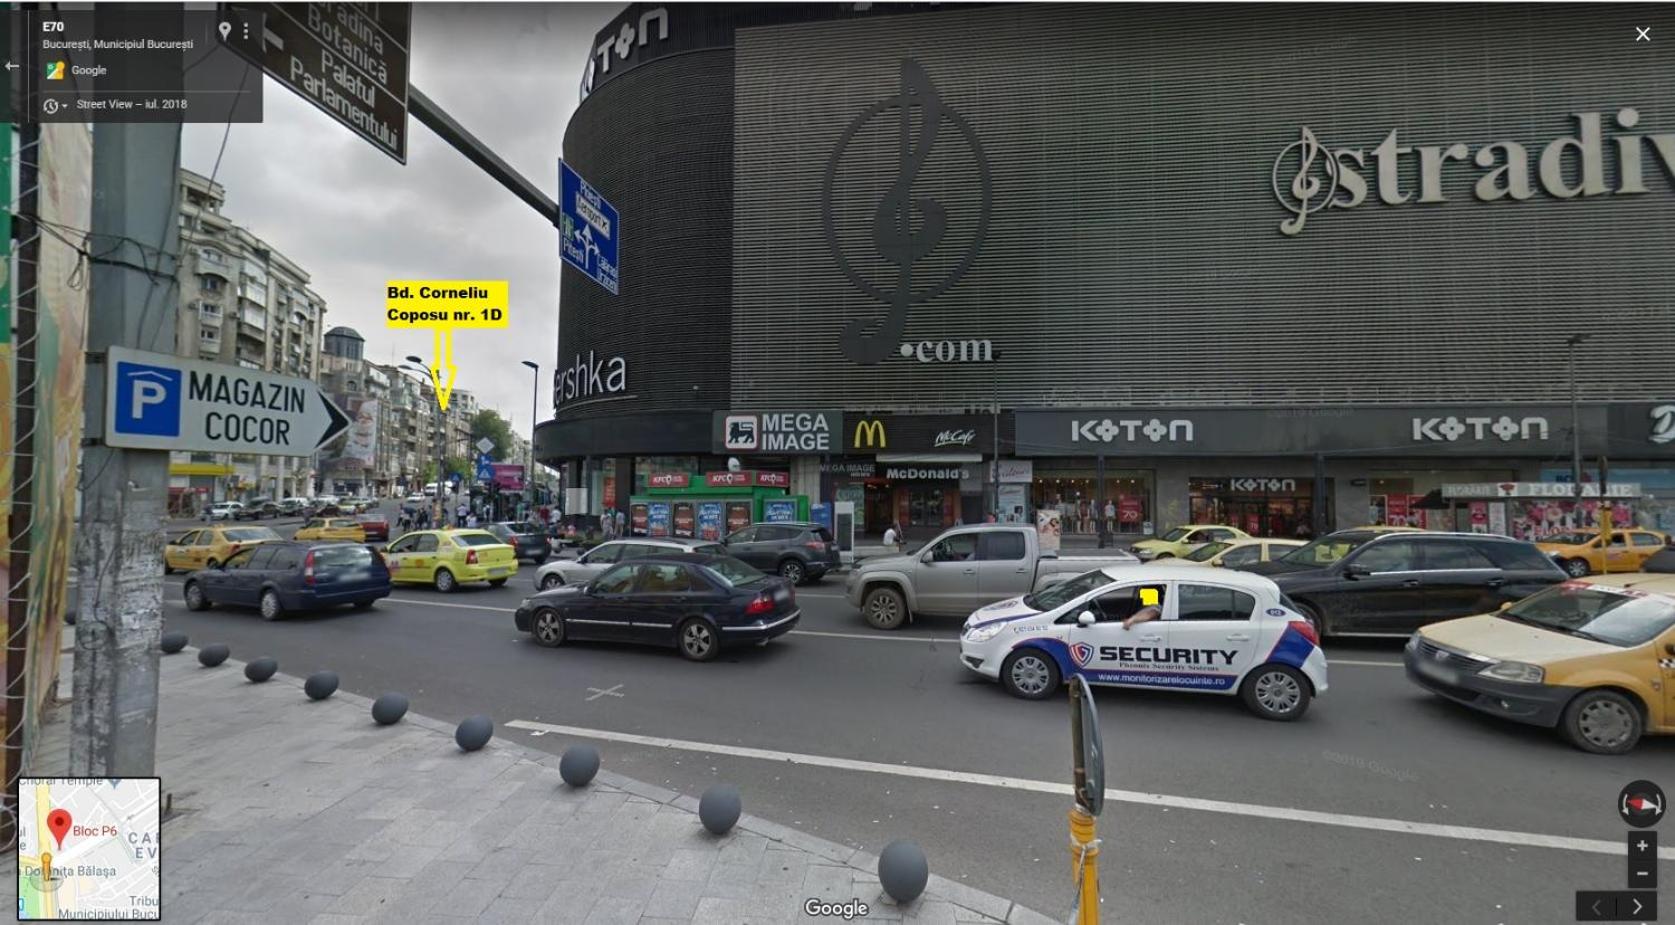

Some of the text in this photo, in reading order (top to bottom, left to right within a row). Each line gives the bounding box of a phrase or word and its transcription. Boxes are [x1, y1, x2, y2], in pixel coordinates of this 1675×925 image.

[321, 49, 376, 108] Palatul
[290, 56, 399, 151] Parlamentului
[554, 350, 626, 405] ershka
[188, 370, 305, 414] MAGAZIN
[205, 412, 290, 445] COCOR
[762, 413, 829, 432] MEGA
[762, 433, 830, 450] IMAGE
[886, 467, 969, 480] McDonald's
[1099, 646, 1239, 665] SECURITY
[1098, 673, 1226, 686] www.monitorizarelocuinte.ro
